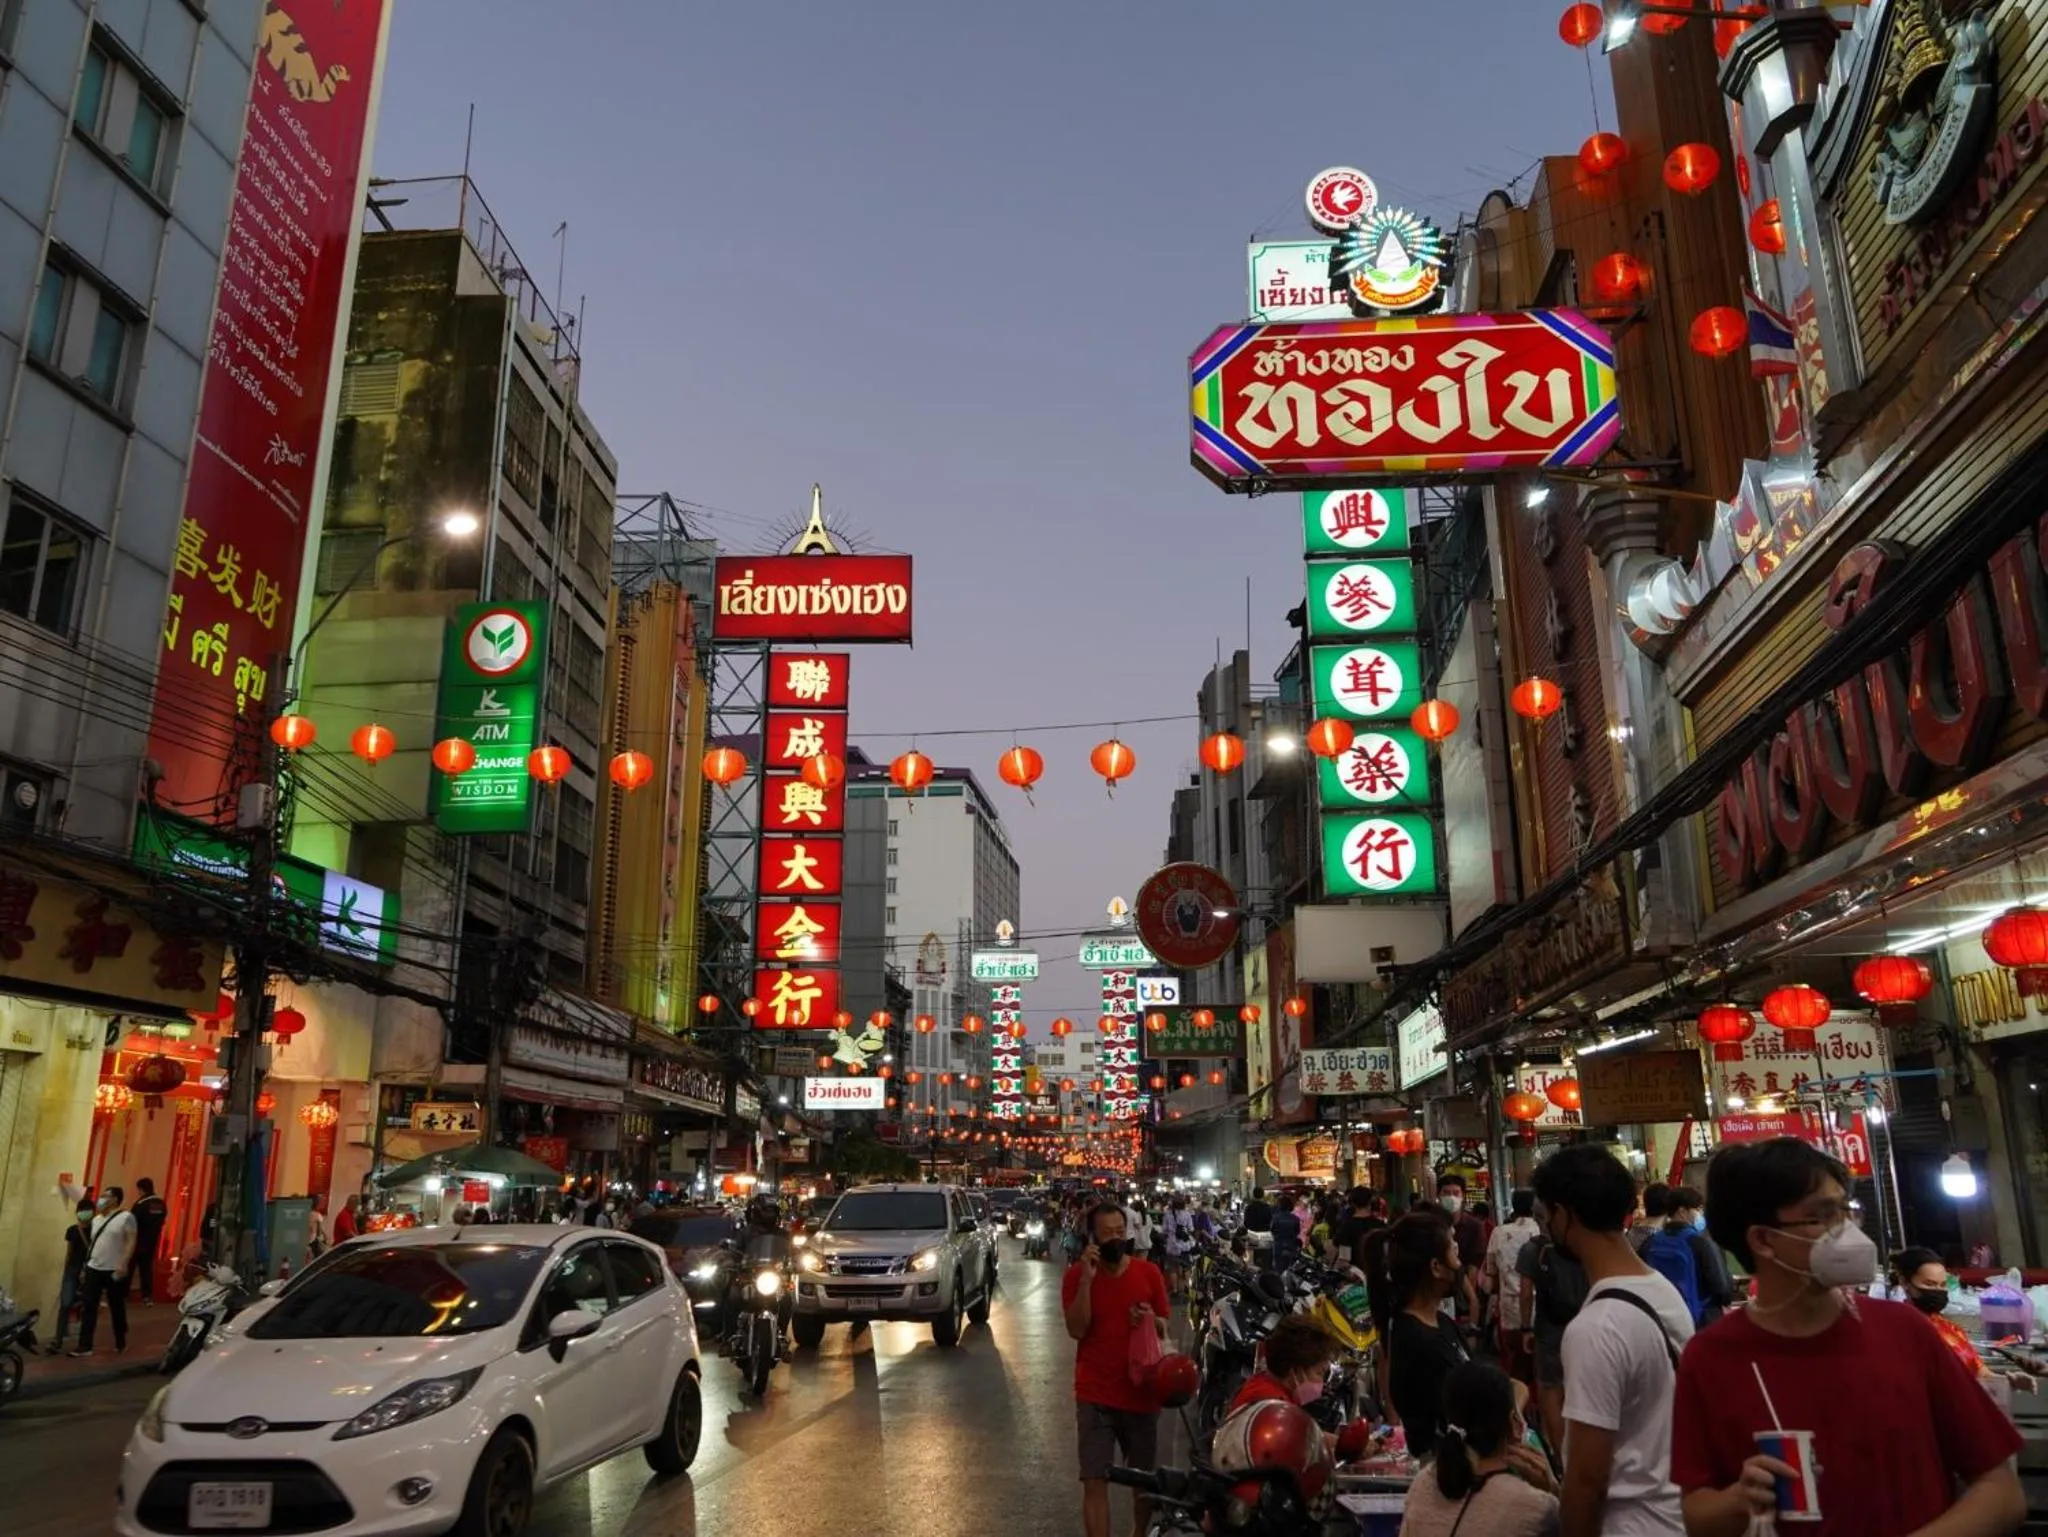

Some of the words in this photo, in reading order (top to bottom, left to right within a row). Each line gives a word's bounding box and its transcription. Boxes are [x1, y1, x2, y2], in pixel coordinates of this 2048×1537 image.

[1253, 340, 1415, 377] ห้างทอง
[175, 518, 282, 629] 喜发财
[720, 569, 907, 616] เลี่ยงเซ่งเฮง
[234, 656, 267, 714] สุข
[472, 724, 510, 740] ATM
[452, 785, 518, 796] WISDOM
[1139, 982, 1176, 1002] ttb
